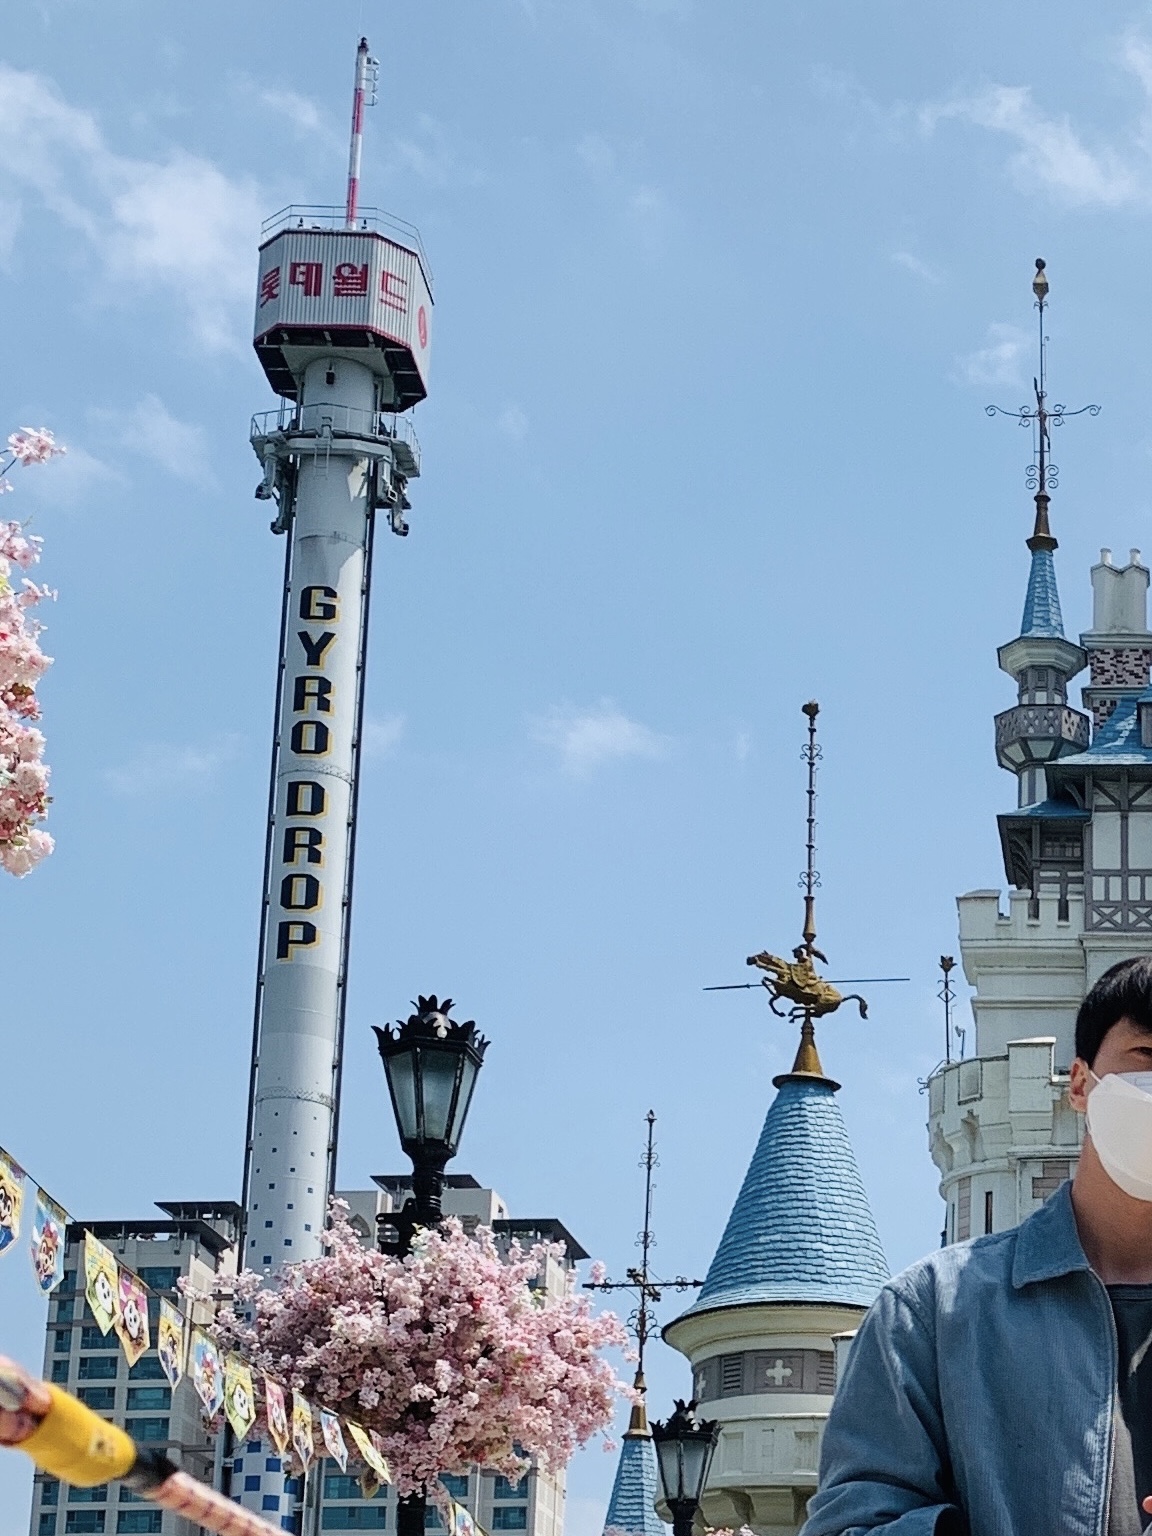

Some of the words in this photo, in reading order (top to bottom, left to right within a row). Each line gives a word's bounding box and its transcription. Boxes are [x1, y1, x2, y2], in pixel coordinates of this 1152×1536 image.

[260, 262, 408, 314] 롯데월드
[291, 586, 340, 758] GYRO
[276, 781, 328, 961] DROP
